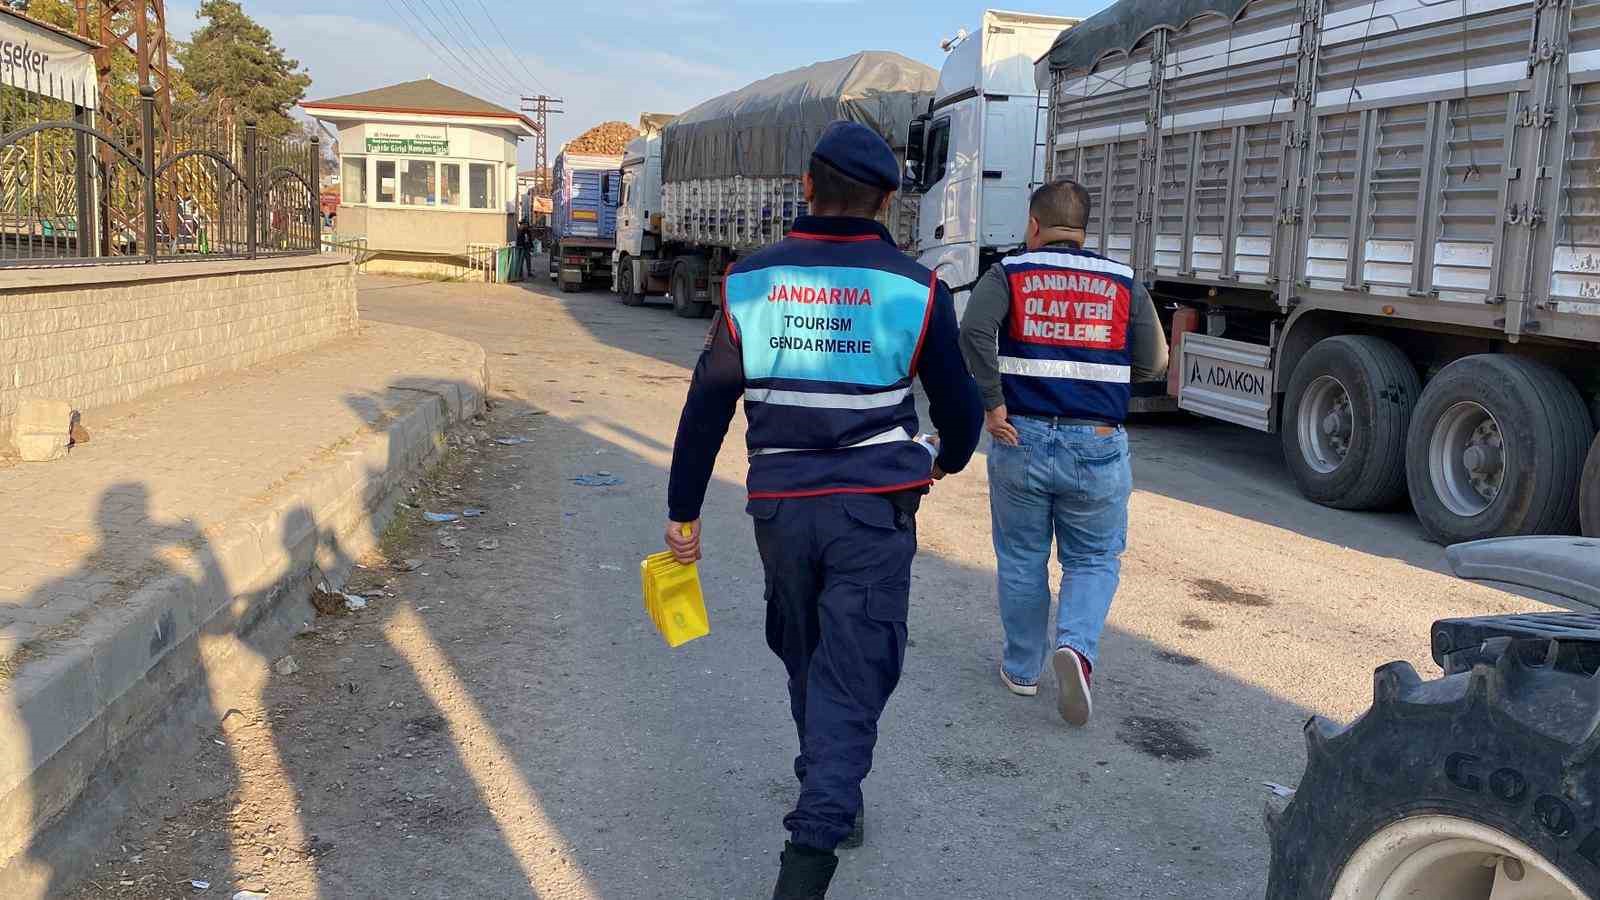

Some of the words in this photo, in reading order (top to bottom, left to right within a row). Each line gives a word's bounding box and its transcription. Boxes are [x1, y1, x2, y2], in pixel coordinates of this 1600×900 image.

[0, 40, 48, 75] şeker
[768, 285, 872, 306] JANDARMA
[1022, 274, 1117, 300] JANDARMA
[1025, 298, 1070, 318] OLAY
[1073, 300, 1113, 320] YERİ
[784, 315, 852, 331] TOURISM
[1023, 316, 1112, 342] İNCELEME
[769, 336, 871, 353] GENDARMERIE
[1207, 366, 1264, 396] ADAKON
